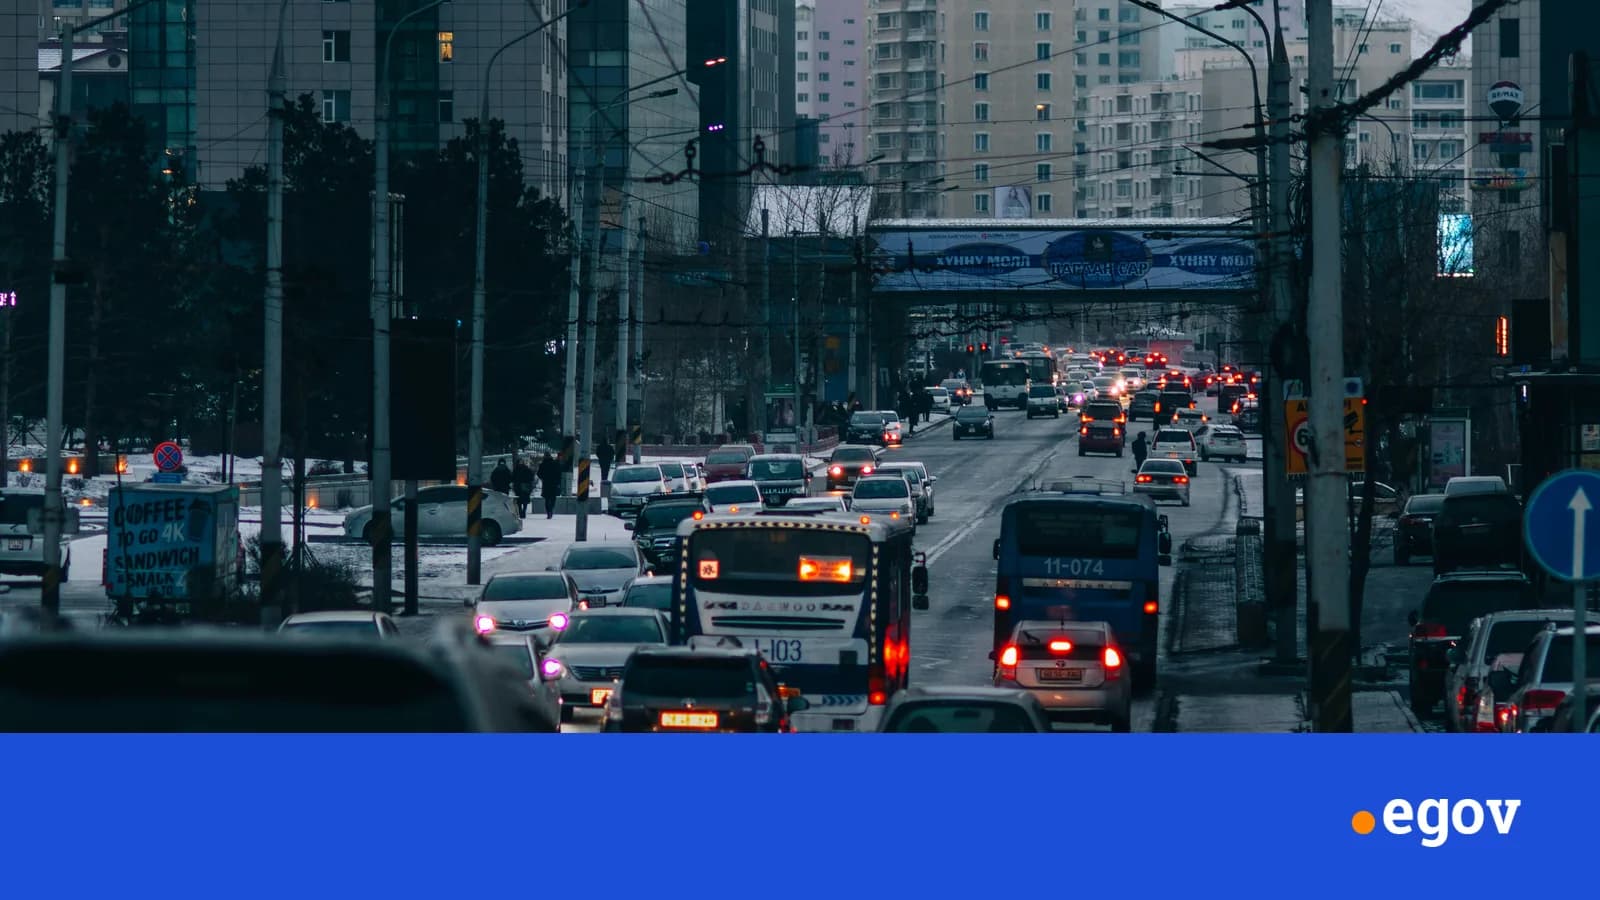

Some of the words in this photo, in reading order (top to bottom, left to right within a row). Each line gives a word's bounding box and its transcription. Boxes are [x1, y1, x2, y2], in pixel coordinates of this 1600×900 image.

[1051, 262, 1113, 276] ЦАГААН
[1117, 261, 1149, 276] САР
[114, 498, 185, 527] COFFEE
[117, 531, 134, 547] TO
[139, 530, 158, 545] GO
[161, 523, 185, 543] 4K
[115, 546, 200, 570] SANDWICH
[1044, 558, 1104, 576] 11-074
